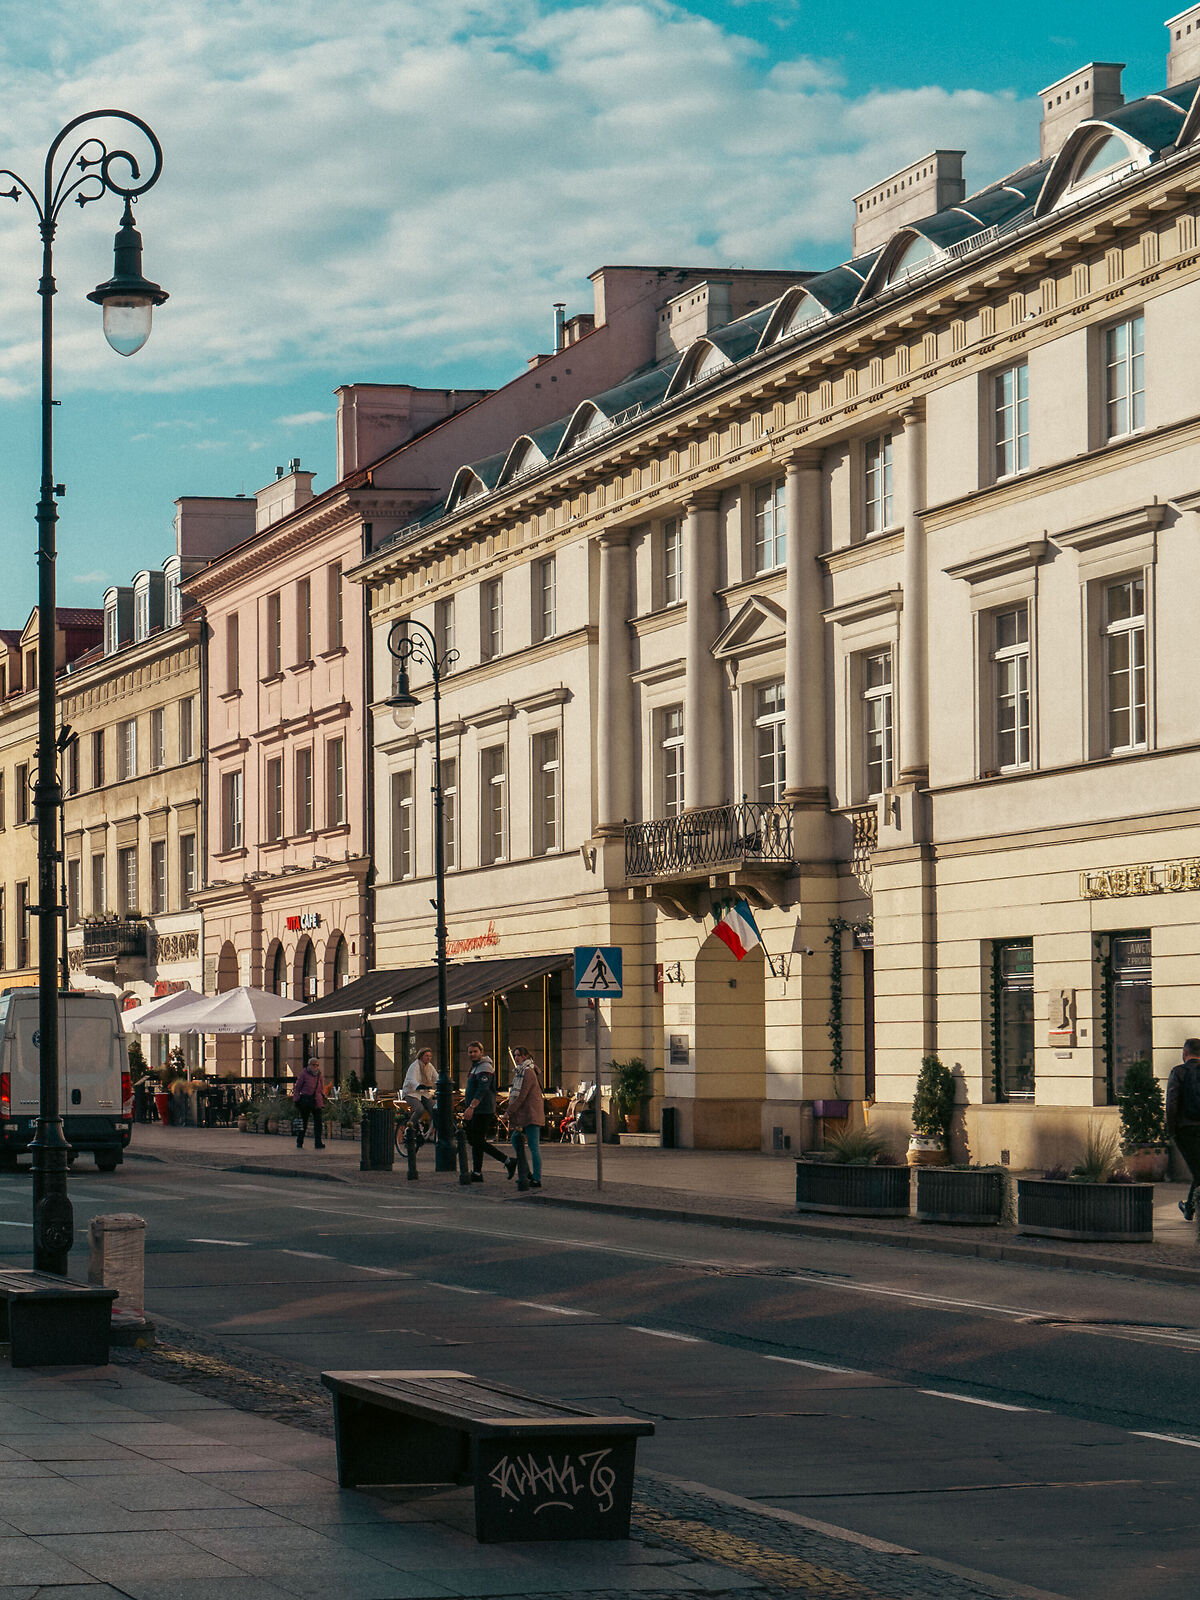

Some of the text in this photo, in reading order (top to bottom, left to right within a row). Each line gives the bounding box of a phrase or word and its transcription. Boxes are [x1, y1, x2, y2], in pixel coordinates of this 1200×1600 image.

[1079, 865, 1163, 898] LABEL
[286, 913, 318, 931] VITA CAFE
